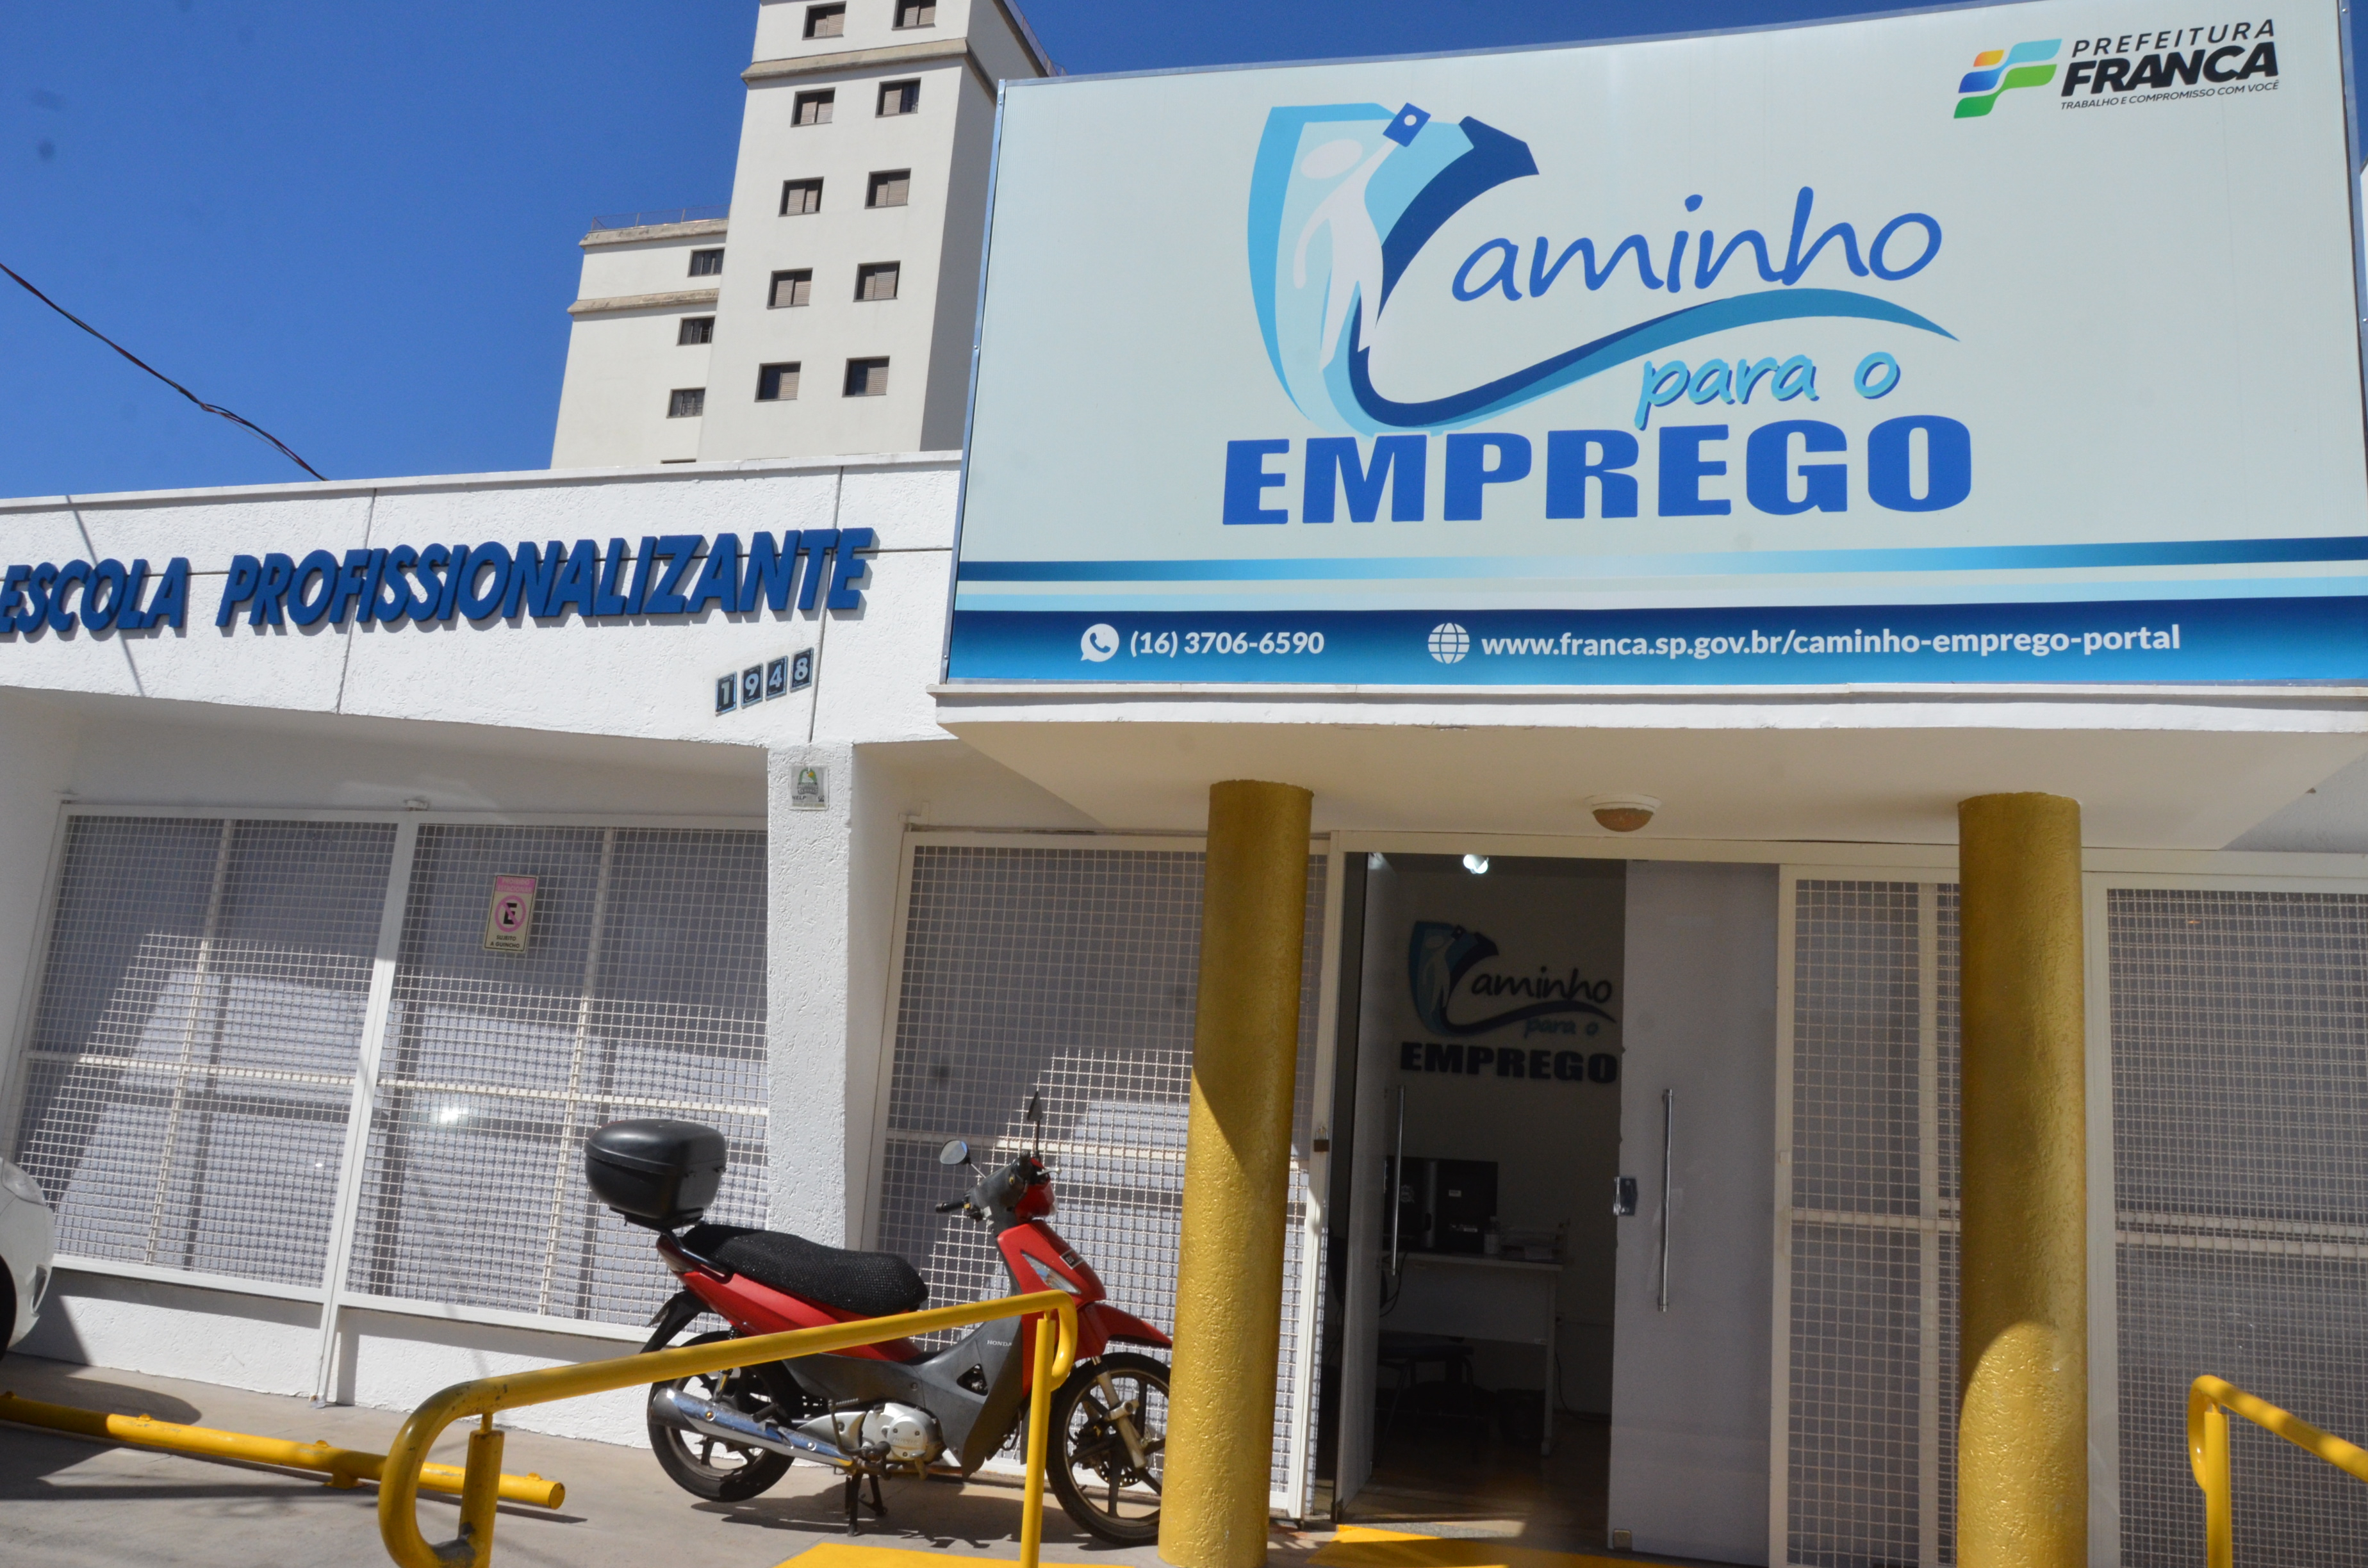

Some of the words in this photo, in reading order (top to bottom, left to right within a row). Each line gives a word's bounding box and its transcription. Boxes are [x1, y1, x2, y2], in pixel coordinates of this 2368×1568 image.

[2071, 19, 2274, 58] PREFEITURA
[2060, 42, 2279, 97] FRANCA
[2060, 97, 2119, 110] TRABALHO
[2121, 97, 2127, 105] E
[2129, 88, 2215, 104] COMPROMISSO
[2217, 86, 2245, 96] COM
[2248, 79, 2280, 93] VOCÊ
[1634, 354, 1819, 430] para
[1854, 352, 1902, 399] o
[1222, 415, 1971, 525] EMPREGO
[0, 557, 190, 634] ESCOLA
[215, 527, 875, 628] PROFISSIONALIZANTE
[1130, 631, 1178, 657] (16)
[1185, 632, 1325, 655] 3706-6590
[1481, 624, 2181, 659] www.franca.sp.gov.br/caminho-emprego-portal
[721, 657, 809, 705] 1948
[1524, 1018, 1577, 1038] para
[1586, 1020, 1599, 1036] o
[1400, 1041, 1618, 1084] EMPREGO
